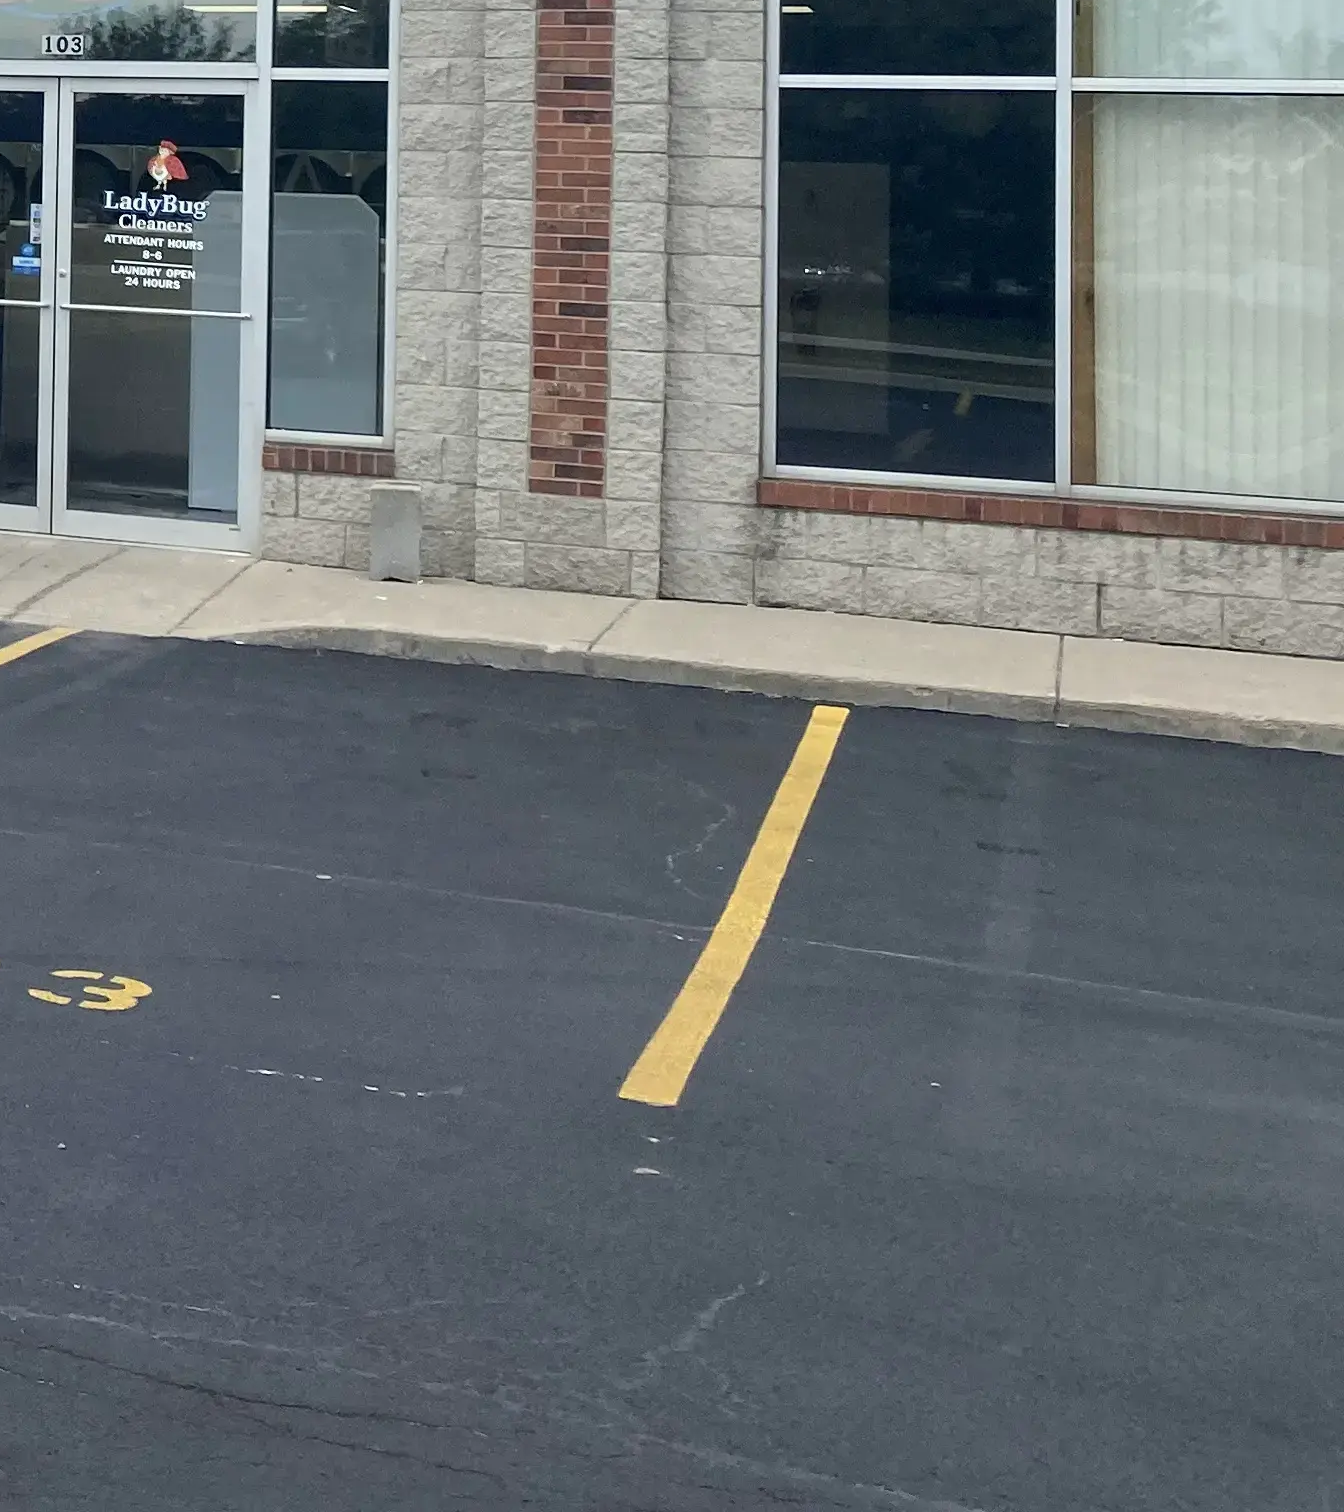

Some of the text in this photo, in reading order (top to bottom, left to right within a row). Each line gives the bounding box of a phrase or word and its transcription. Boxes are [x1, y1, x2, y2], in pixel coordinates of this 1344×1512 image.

[44, 36, 82, 53] 103
[104, 190, 210, 219] LadyBug
[118, 214, 193, 233] Cleaners
[104, 233, 204, 250] ATTENDANT HOURS
[110, 264, 196, 280] LAUNDRY OPEN
[124, 277, 181, 290] 24 HOURS
